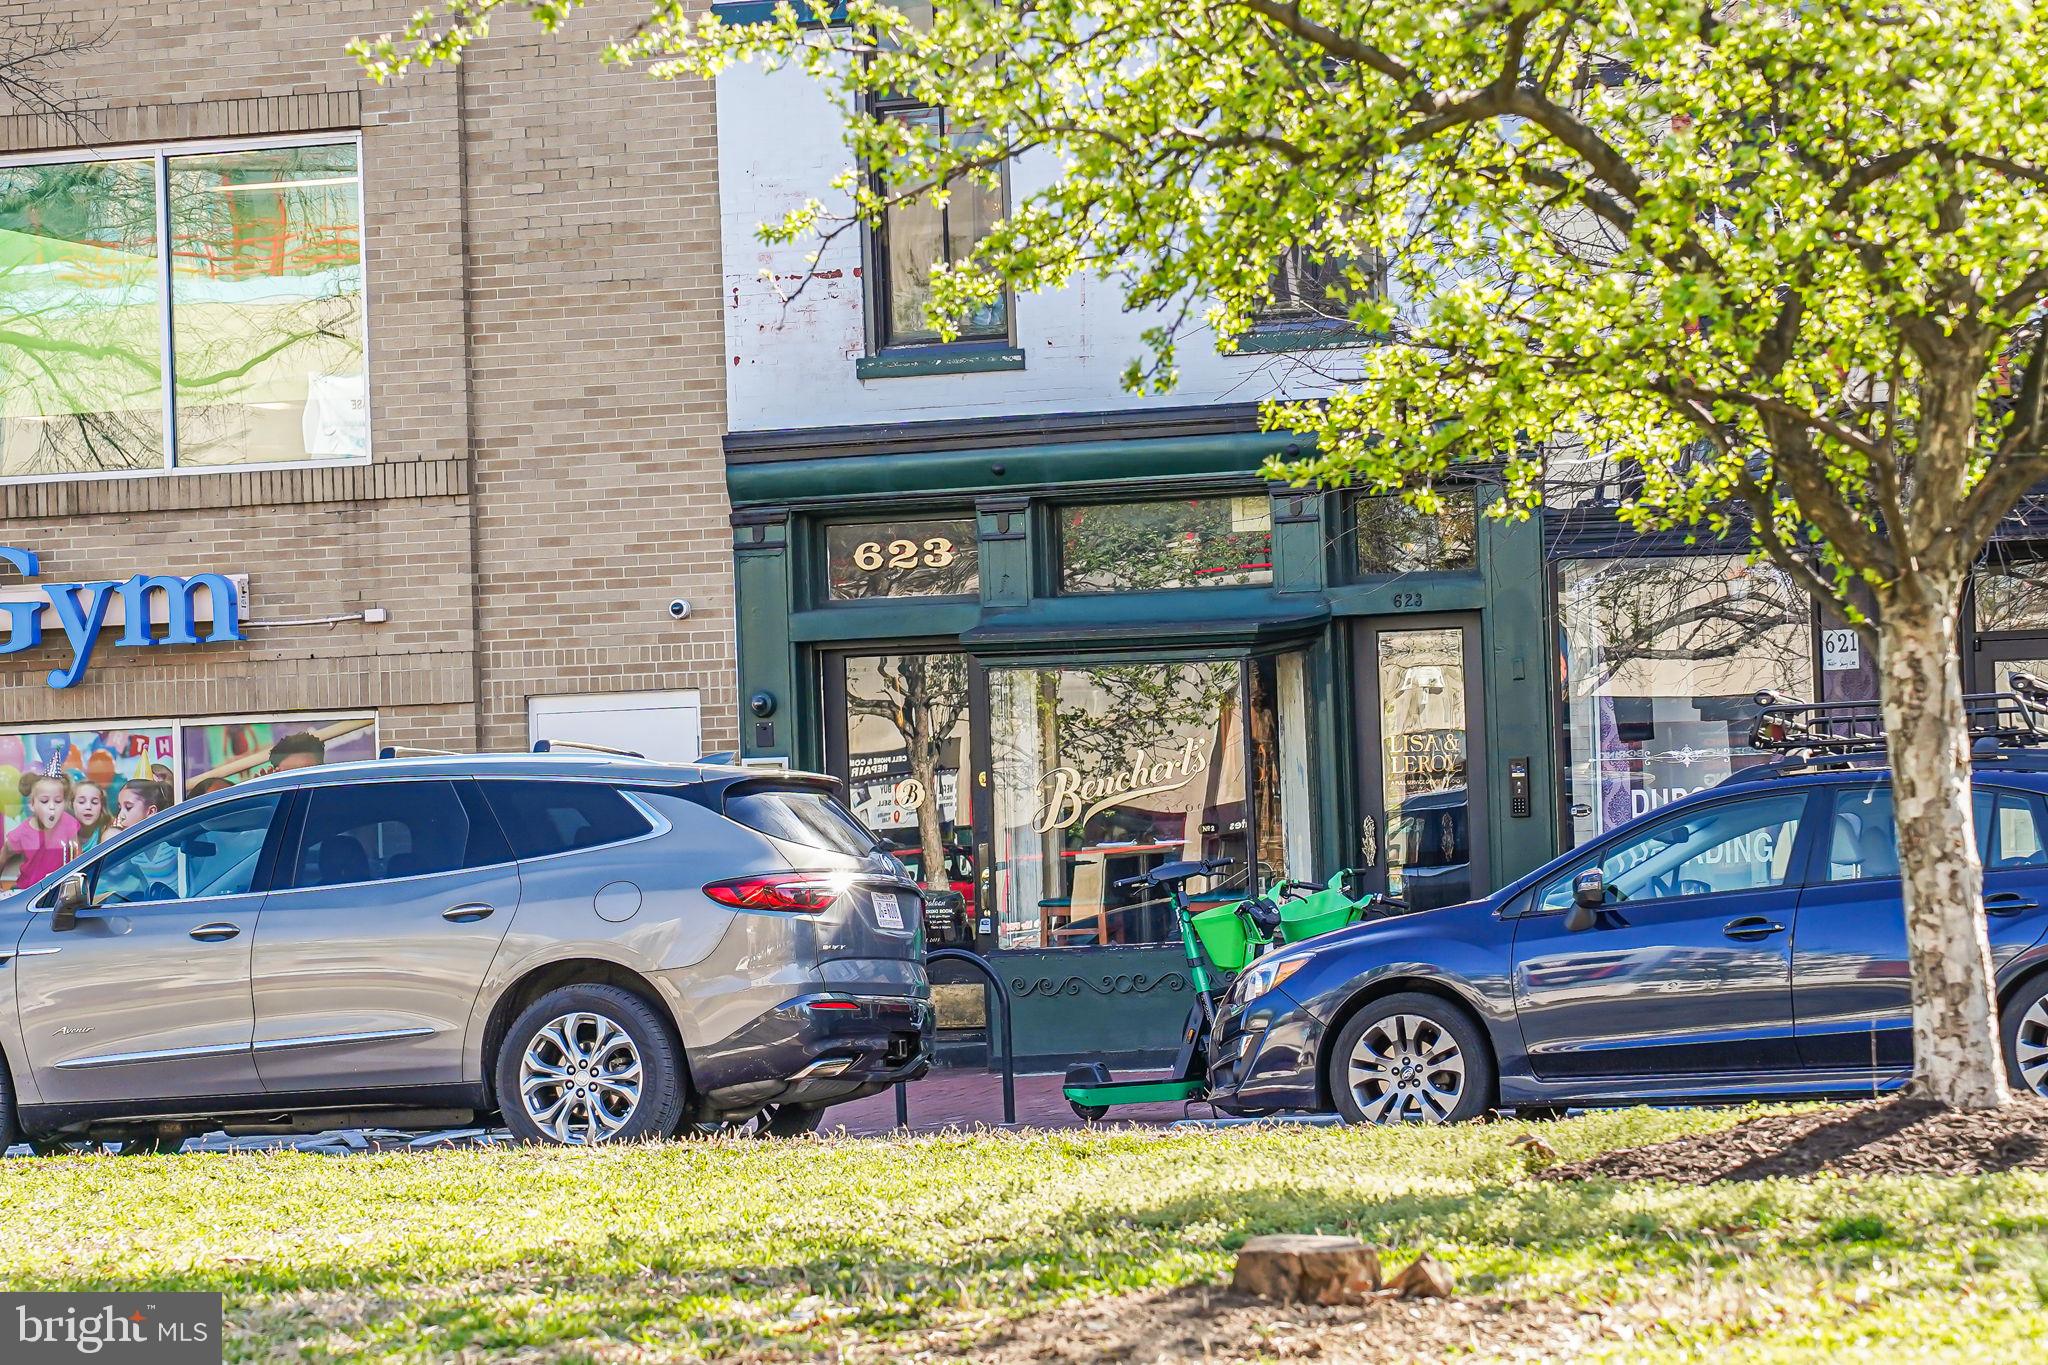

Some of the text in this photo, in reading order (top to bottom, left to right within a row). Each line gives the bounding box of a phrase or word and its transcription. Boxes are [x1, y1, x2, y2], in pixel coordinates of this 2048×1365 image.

[853, 537, 955, 572] 623
[1393, 592, 1423, 609] 623
[1825, 632, 1857, 654] 621
[1389, 733, 1461, 753] LISA &
[1391, 754, 1459, 774] LEROY
